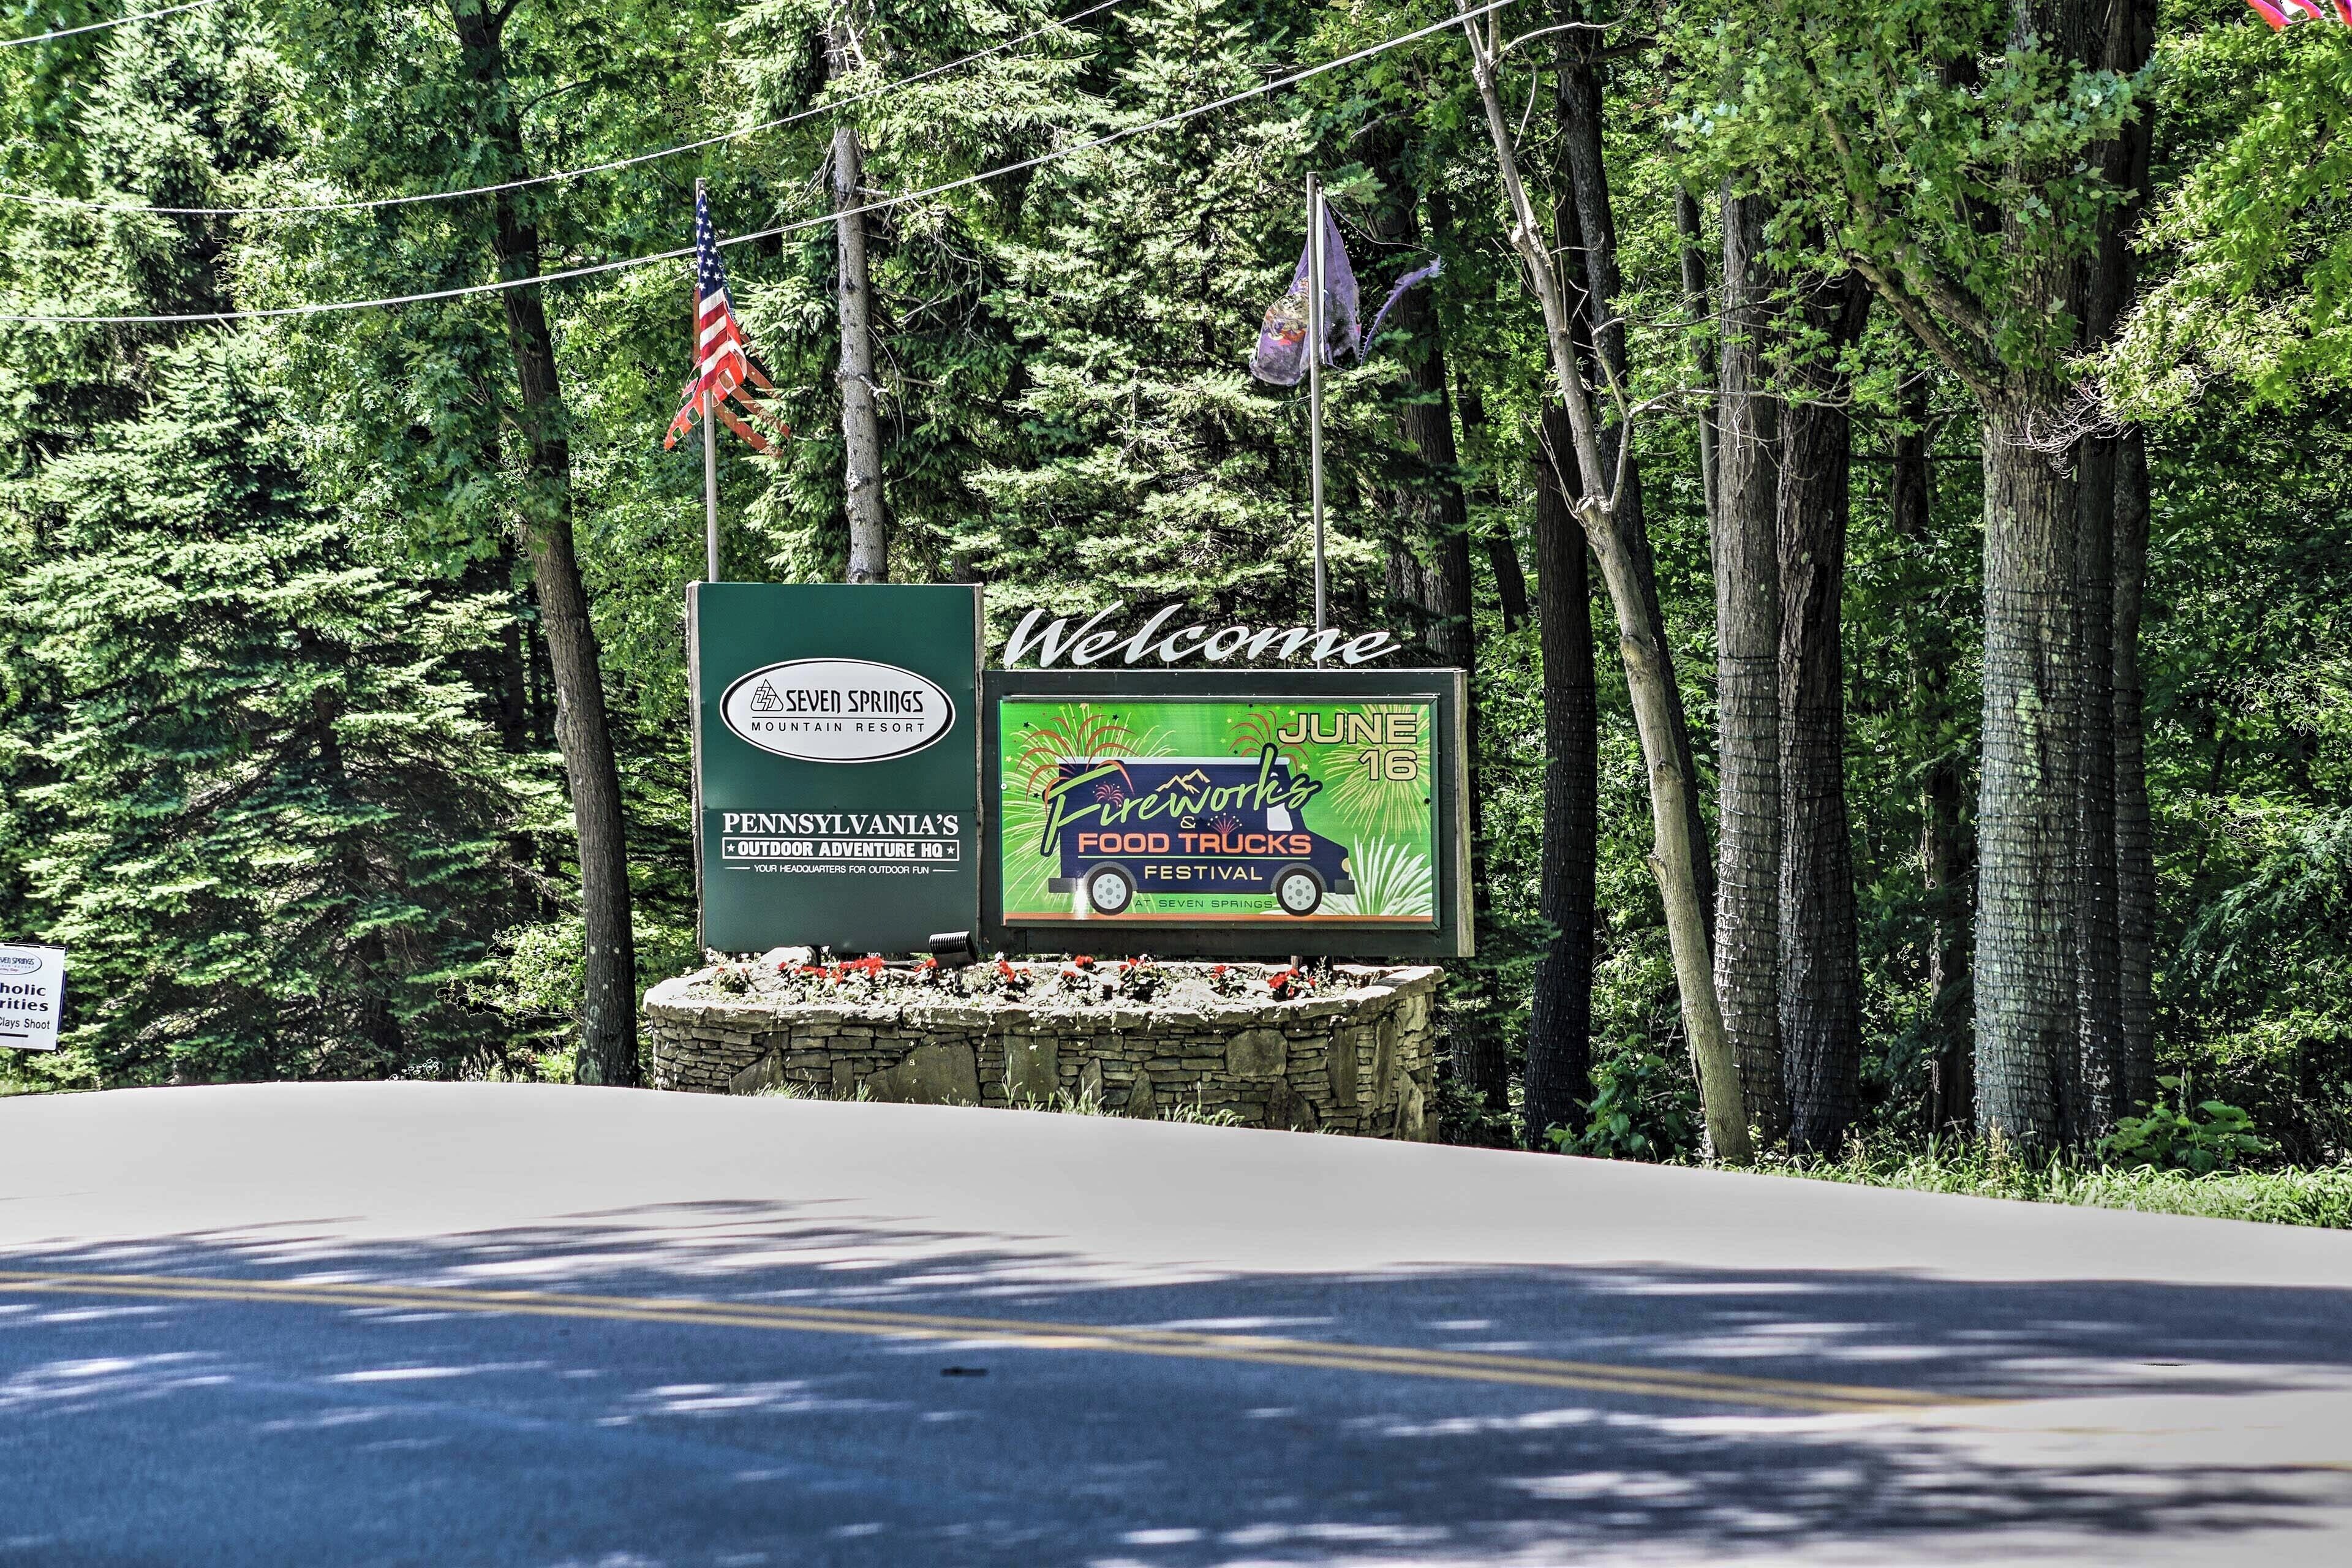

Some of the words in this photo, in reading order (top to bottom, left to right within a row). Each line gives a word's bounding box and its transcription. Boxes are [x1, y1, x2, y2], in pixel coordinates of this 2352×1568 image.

[1002, 600, 1401, 668] Welcome
[786, 690, 840, 714] SEVEN
[848, 690, 924, 714] SPRINGS
[751, 722, 842, 732] MOUNTAIN
[856, 723, 925, 733] RESORT
[1277, 712, 1417, 744] JUNE
[1358, 749, 1418, 781] 16
[1042, 744, 1322, 855] Fireworks
[723, 813, 959, 835] PENNSYLVANIA'S
[1180, 816, 1196, 829] &
[737, 840, 813, 857] OUTDOOR
[818, 842, 915, 858] ADVENTURE
[921, 843, 943, 858] HQ
[1078, 833, 1170, 853] FOOD
[1178, 834, 1312, 854] TRUCKS
[754, 864, 777, 873] YOUR
[780, 864, 846, 874] HEADQUARTERS
[849, 865, 866, 874] FOR
[869, 865, 910, 874] OUTDOOR
[912, 866, 929, 875] FUN
[1144, 865, 1263, 881] FESTIVAL
[1159, 899, 1204, 908] SEVEN
[1211, 900, 1273, 908] SPRINGS
[0, 982, 46, 996] holic
[24, 1018, 50, 1029] Shoot
